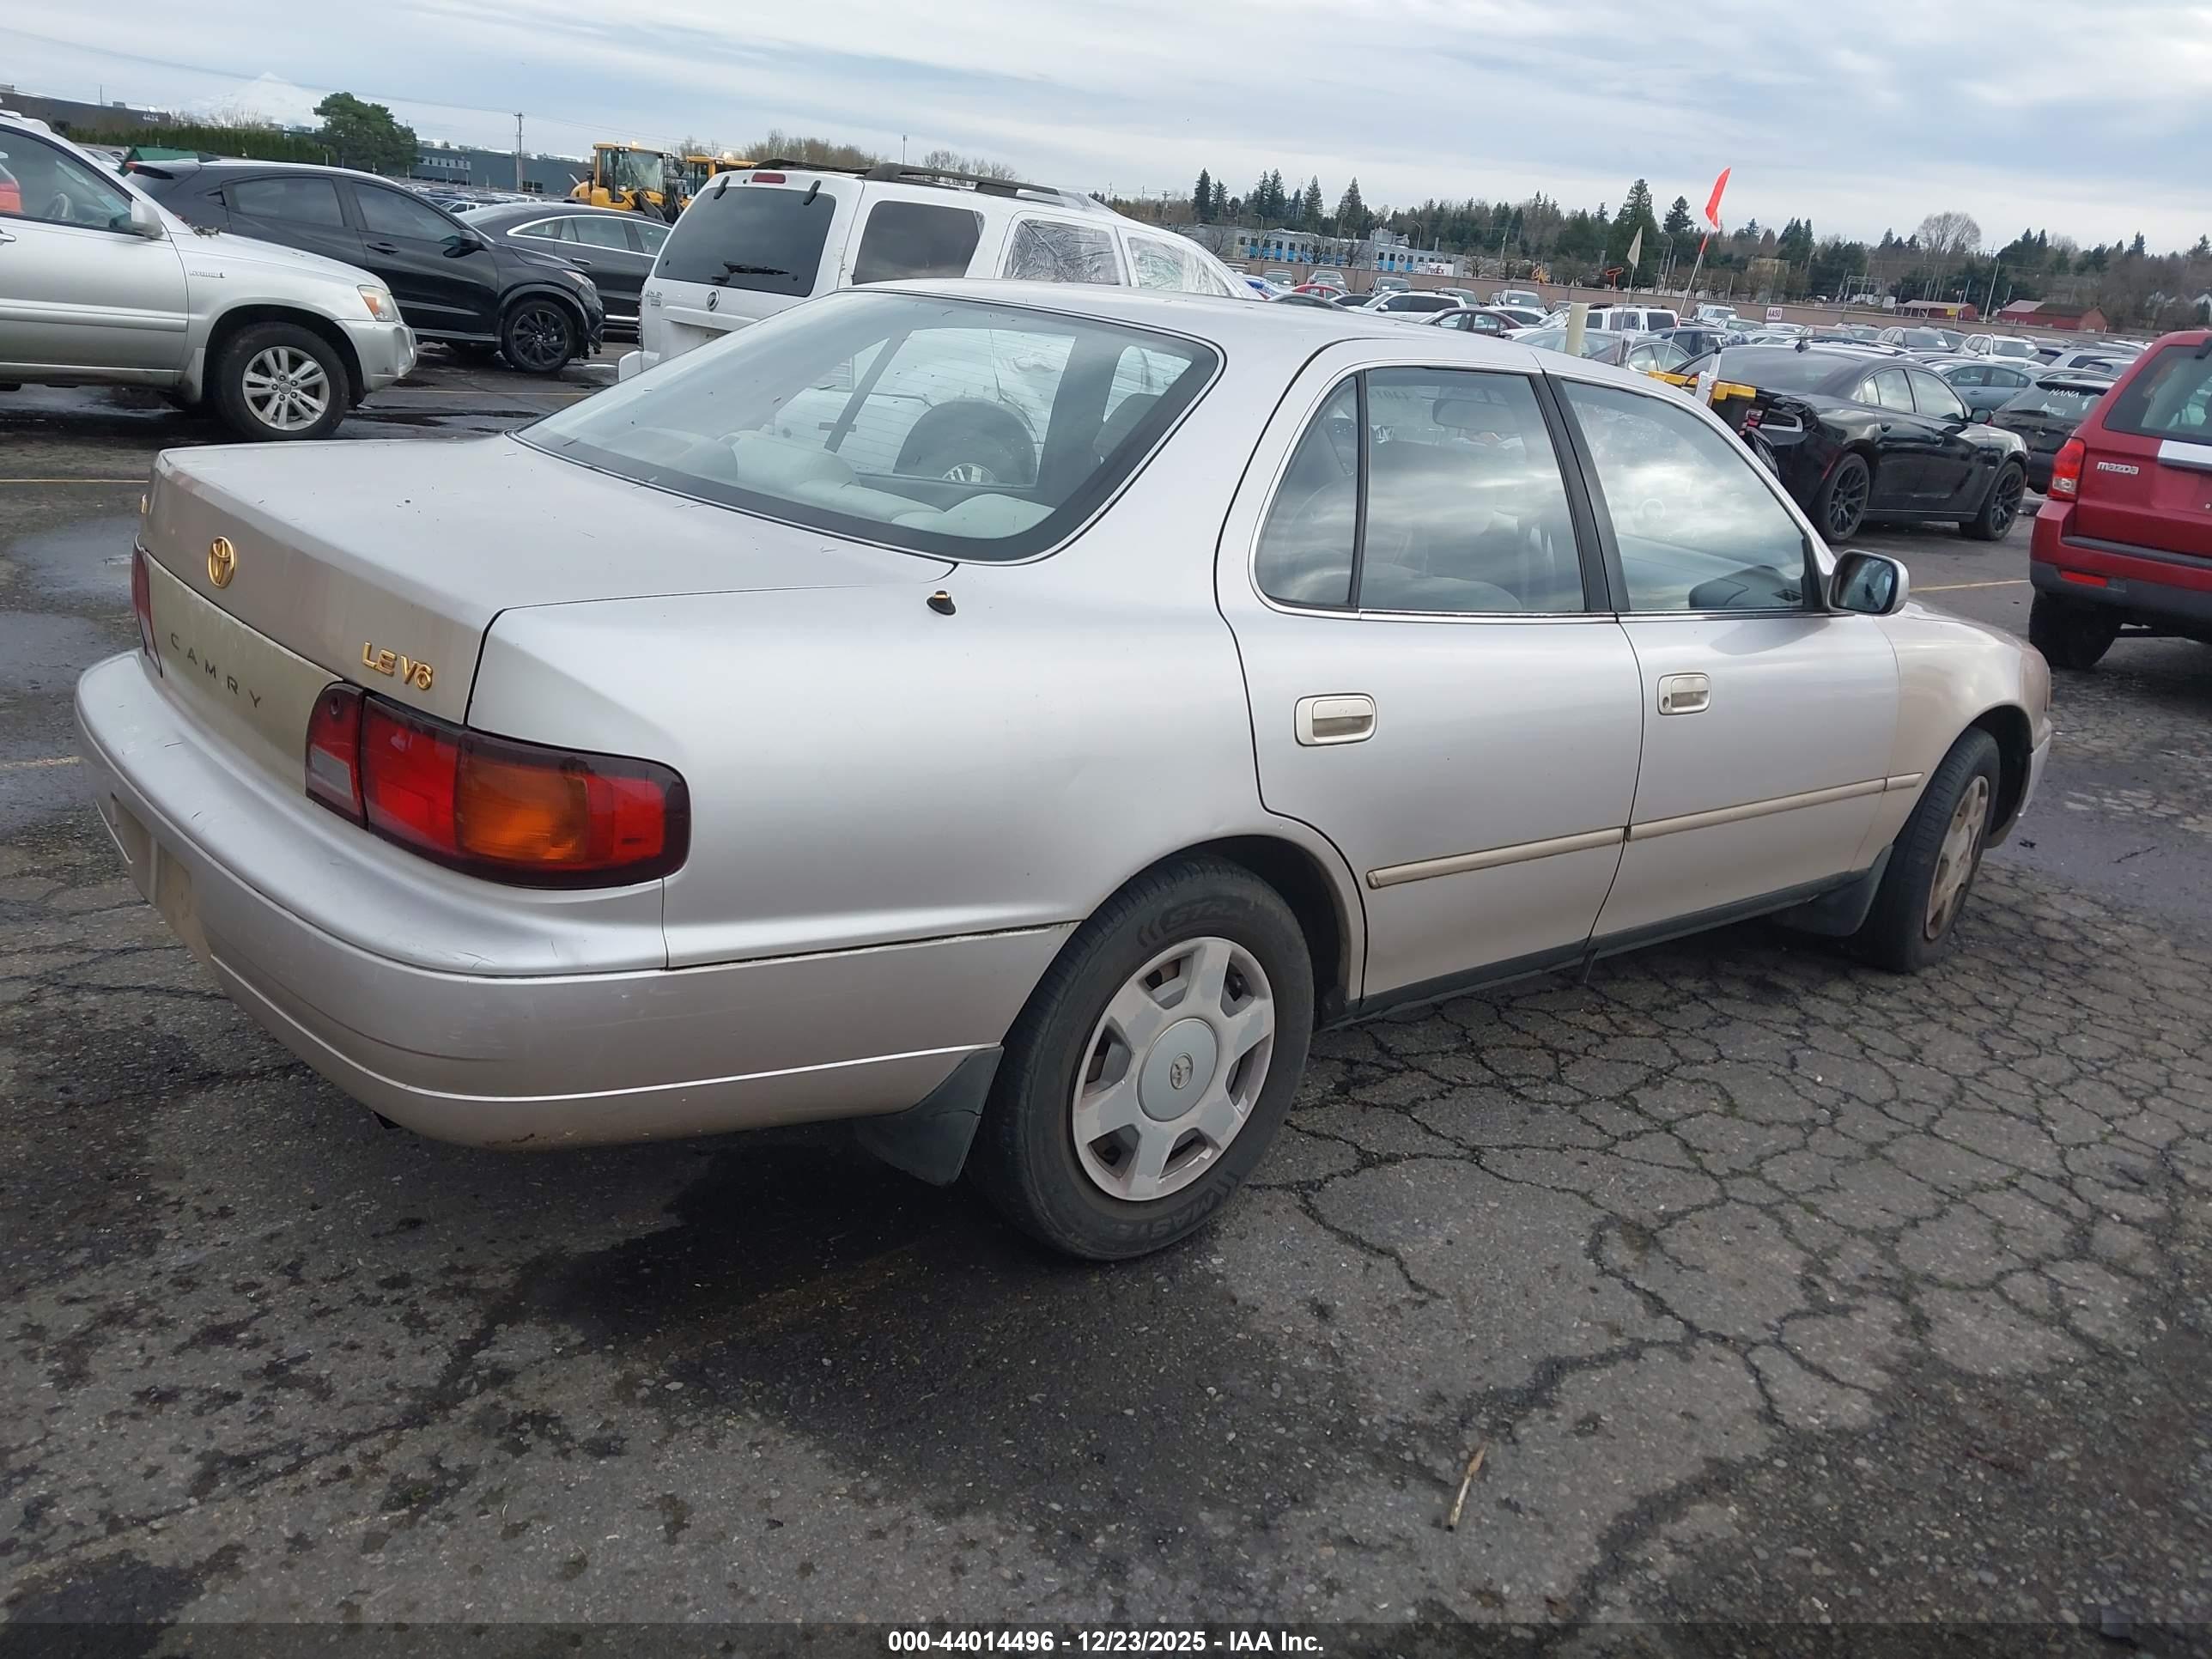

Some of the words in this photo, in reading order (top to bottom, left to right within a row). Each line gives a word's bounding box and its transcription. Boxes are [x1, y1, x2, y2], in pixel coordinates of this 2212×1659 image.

[2048, 388, 2080, 398] HANA
[2097, 461, 2139, 474] mazda
[170, 633, 261, 708] CAMRY
[362, 641, 397, 677] LE
[400, 654, 433, 690] V6
